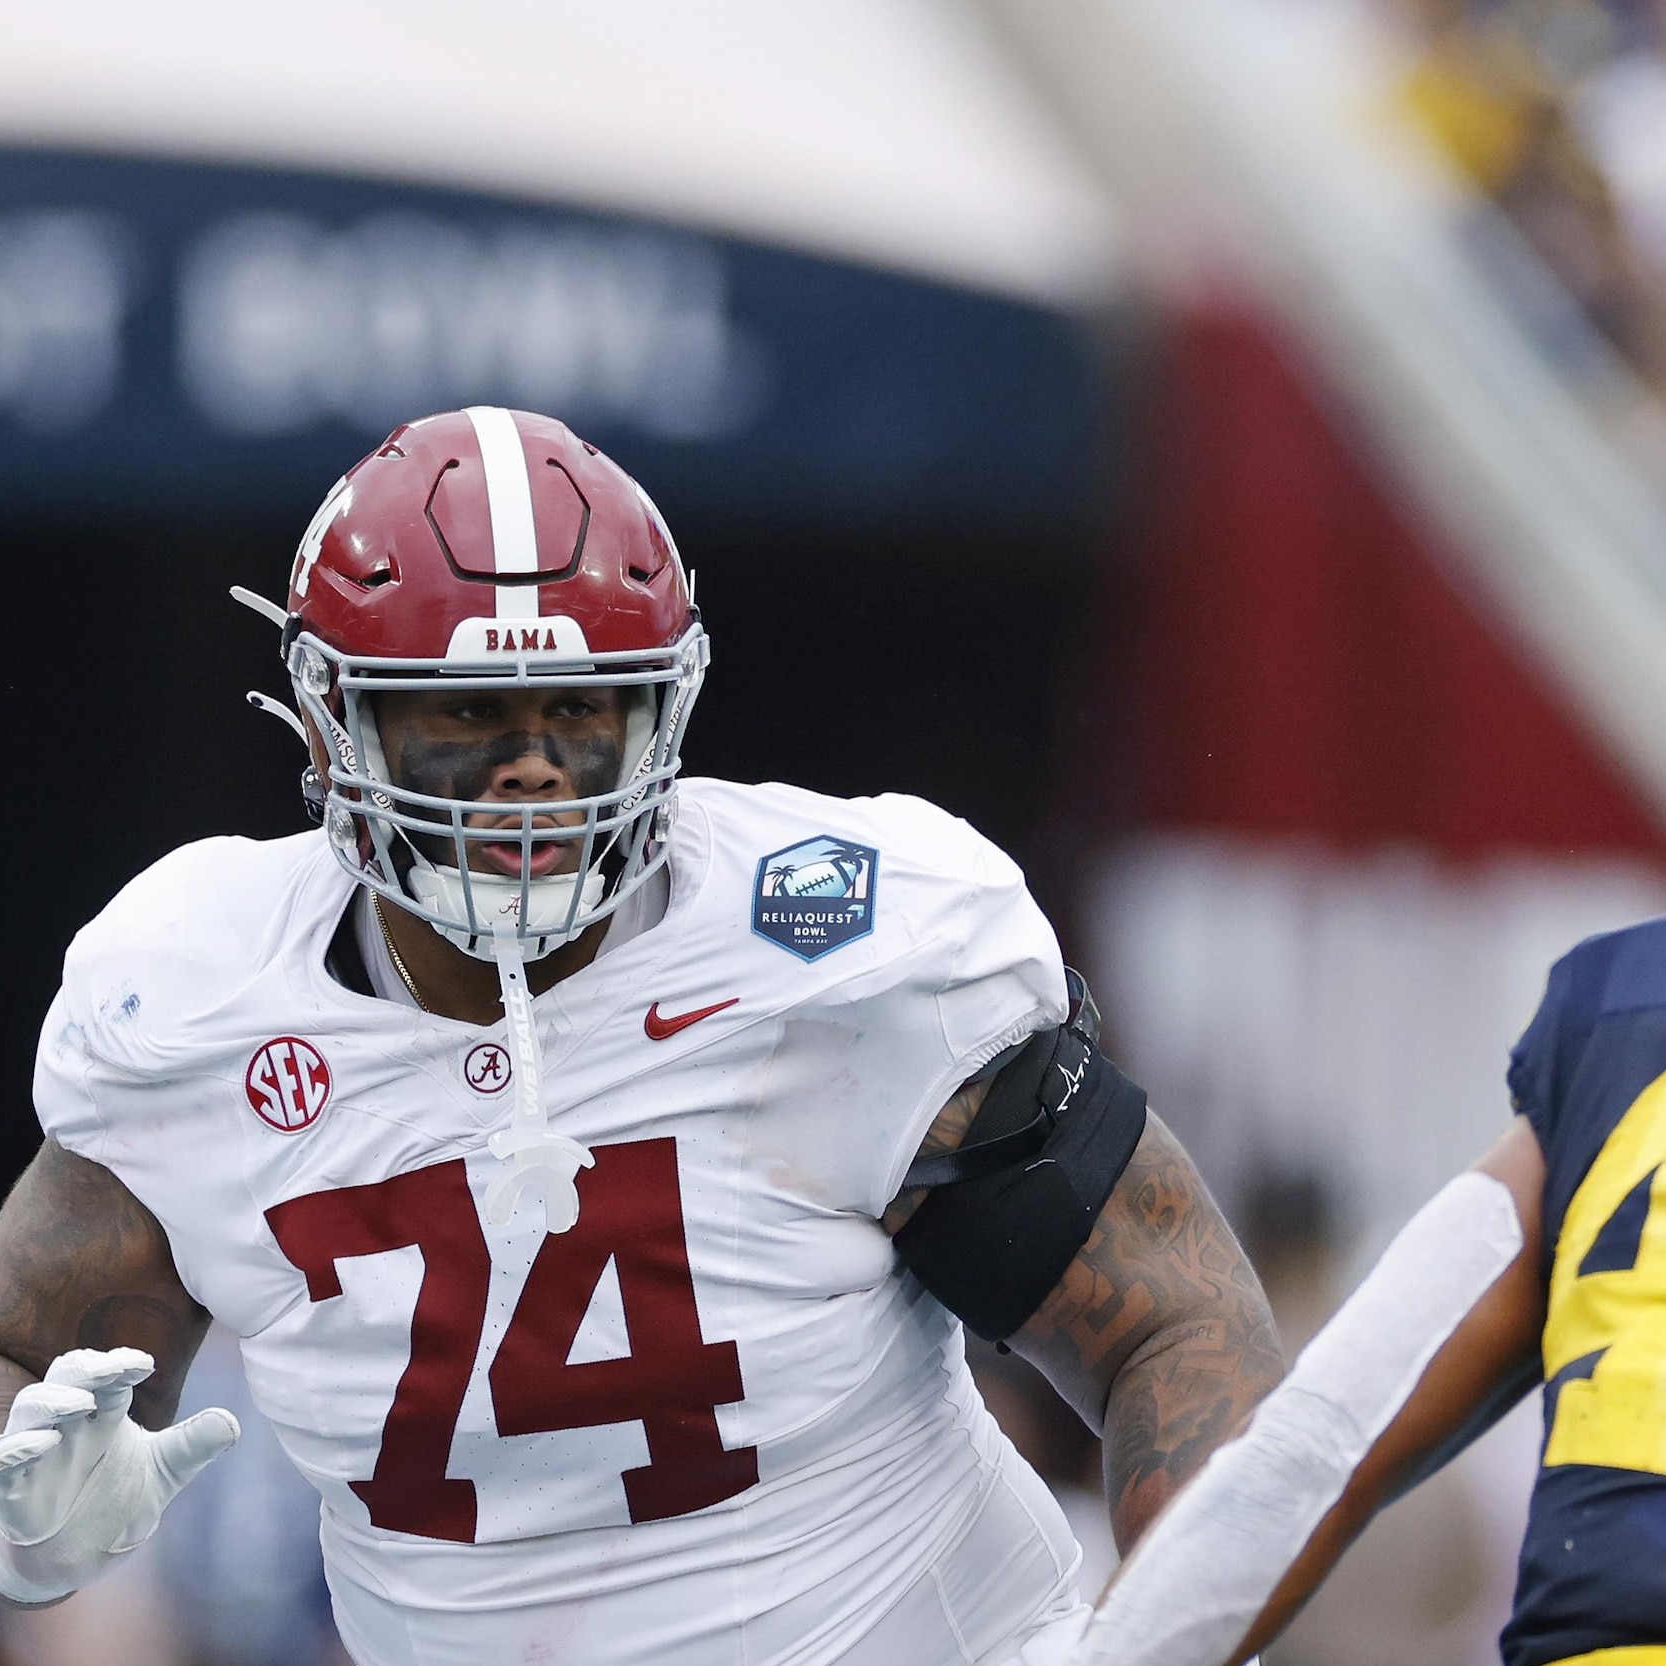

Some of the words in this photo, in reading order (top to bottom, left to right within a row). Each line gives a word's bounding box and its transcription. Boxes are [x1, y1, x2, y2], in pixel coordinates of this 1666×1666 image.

[486, 628, 557, 651] BAMA
[762, 912, 853, 924] RELIAQUEST
[793, 927, 827, 936] BOWL
[471, 1050, 501, 1083] A
[249, 1042, 326, 1126] SEC
[263, 1136, 760, 1544] 74
